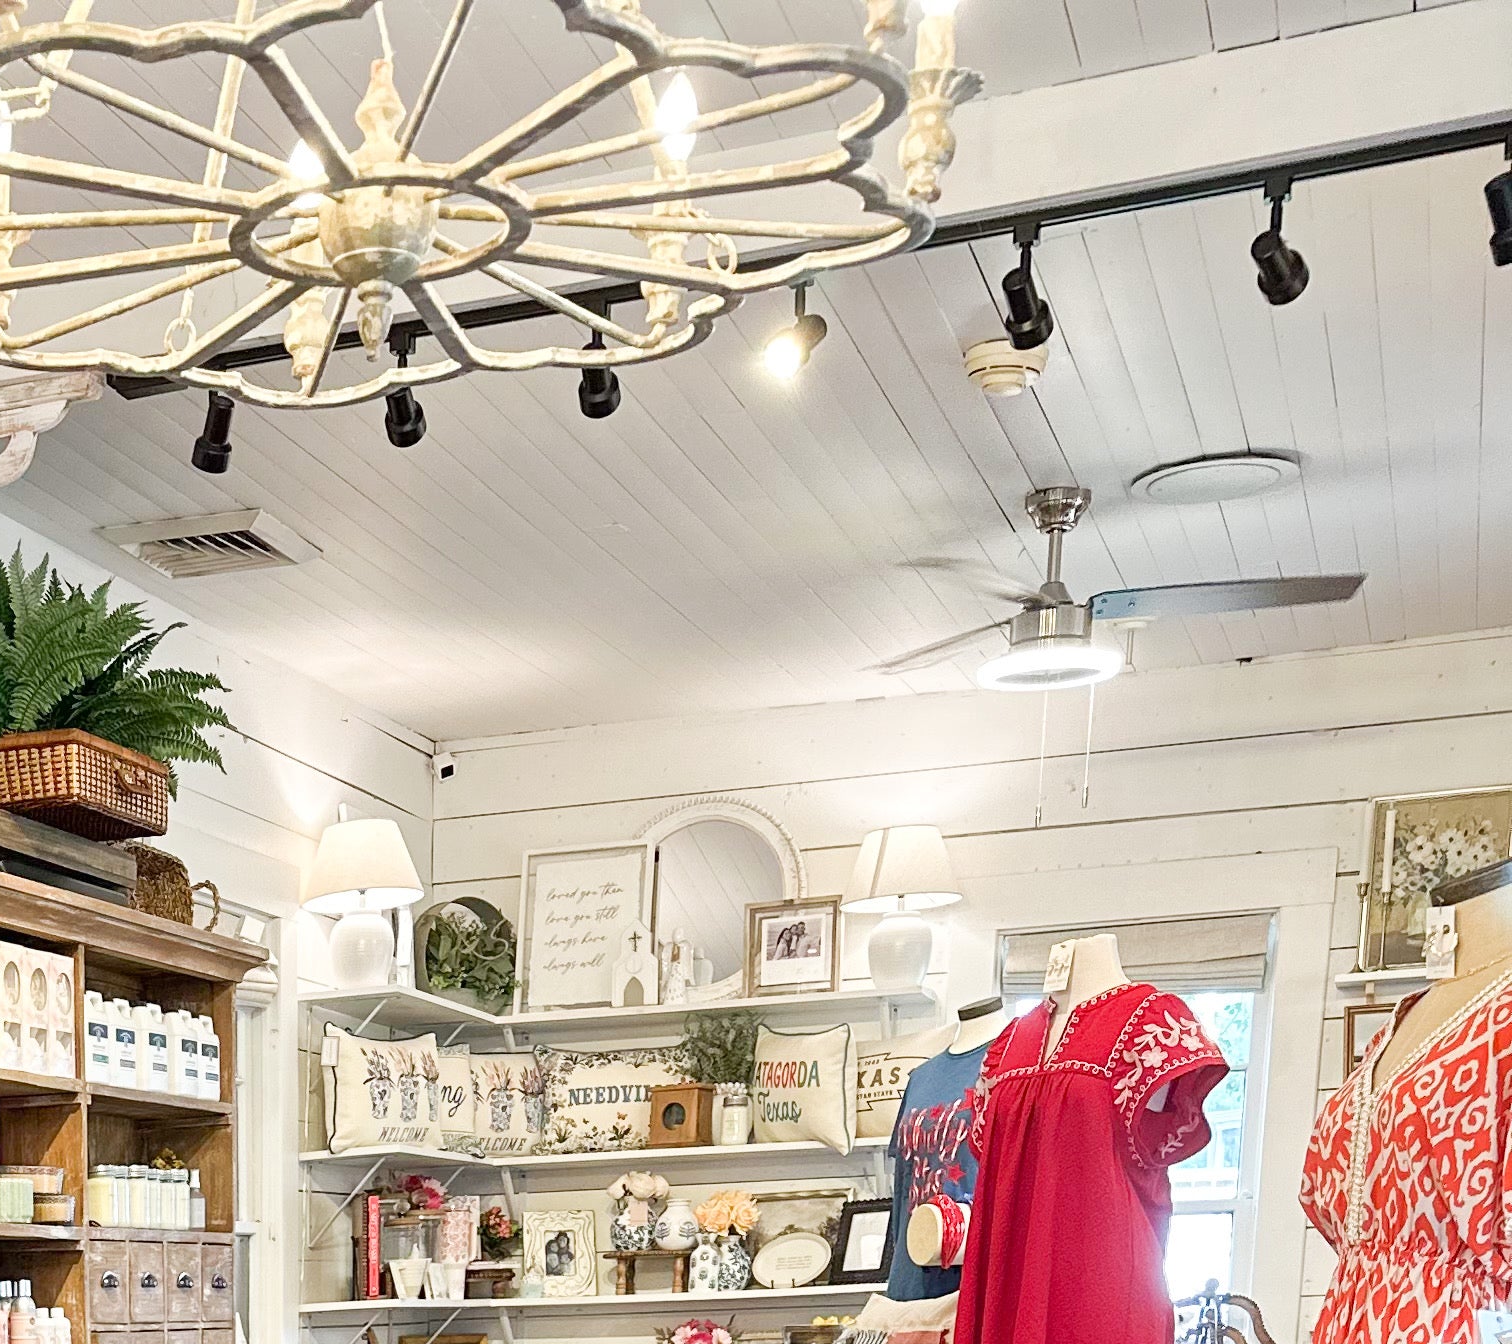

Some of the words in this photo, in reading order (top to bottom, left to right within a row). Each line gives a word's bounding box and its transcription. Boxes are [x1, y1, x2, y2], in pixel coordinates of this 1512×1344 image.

[576, 890, 598, 905] you
[598, 881, 624, 900] then
[569, 914, 591, 928] you
[594, 904, 620, 923] still
[579, 952, 606, 968] will
[755, 1060, 821, 1089] ATAGORDA
[757, 1089, 802, 1123] Texas
[377, 1126, 430, 1142] WELCOME
[478, 1137, 528, 1152] ELCOME
